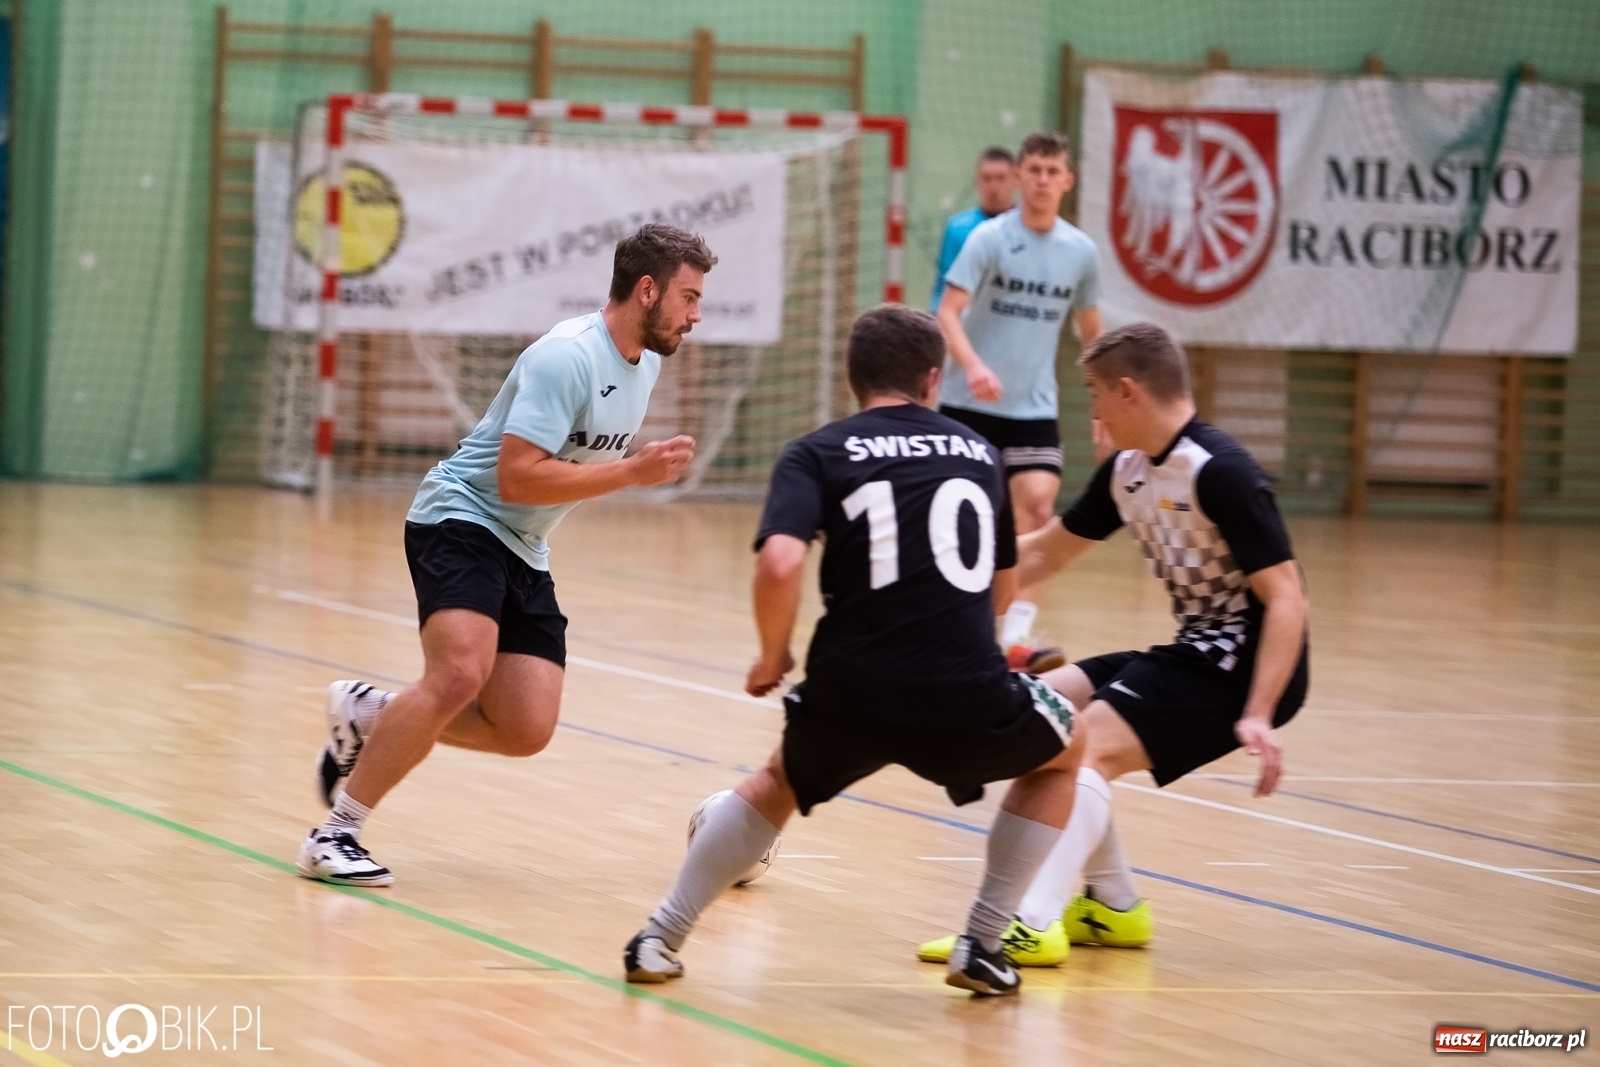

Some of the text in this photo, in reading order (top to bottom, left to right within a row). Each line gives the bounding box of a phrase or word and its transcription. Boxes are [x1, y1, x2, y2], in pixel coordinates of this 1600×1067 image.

[1324, 154, 1532, 208] MIASTO
[425, 250, 506, 302] JEST
[568, 430, 636, 451] ADIC
[844, 434, 995, 466] ŚWISTAK
[840, 477, 996, 594] 10
